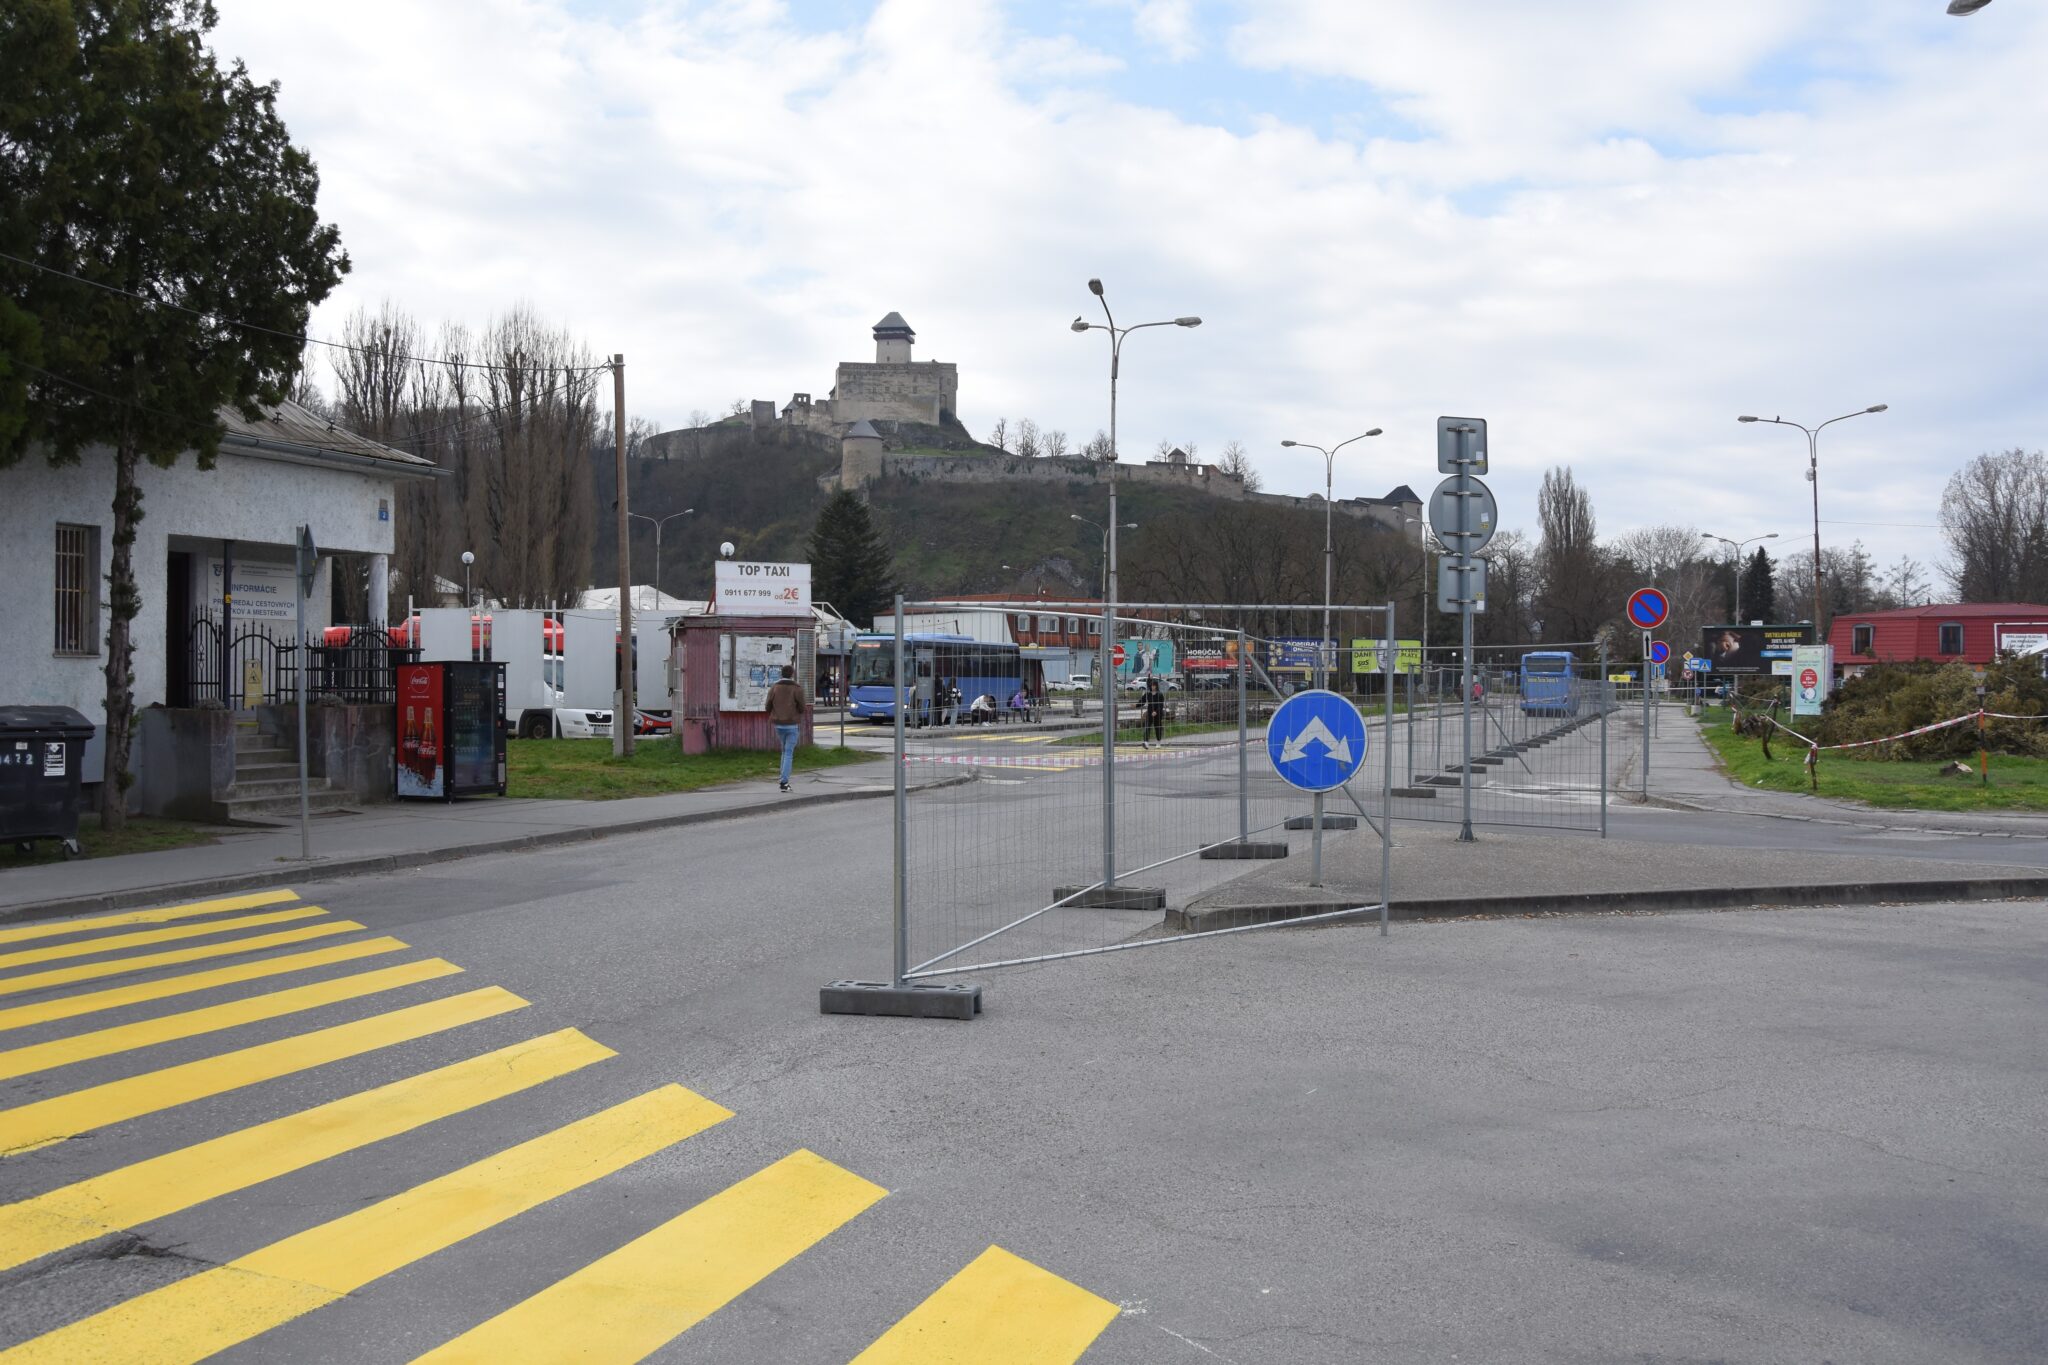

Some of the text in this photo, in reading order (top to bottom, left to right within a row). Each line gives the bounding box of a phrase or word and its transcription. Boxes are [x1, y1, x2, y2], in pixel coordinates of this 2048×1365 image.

[738, 565, 790, 577] TOP TAXI
[231, 583, 277, 594] INFORMÁCIE
[725, 588, 772, 597] 0911 677 999
[783, 587, 799, 600] 2€
[213, 598, 254, 607] PREPREDAJ
[1187, 648, 1222, 656] HORÚČKA
